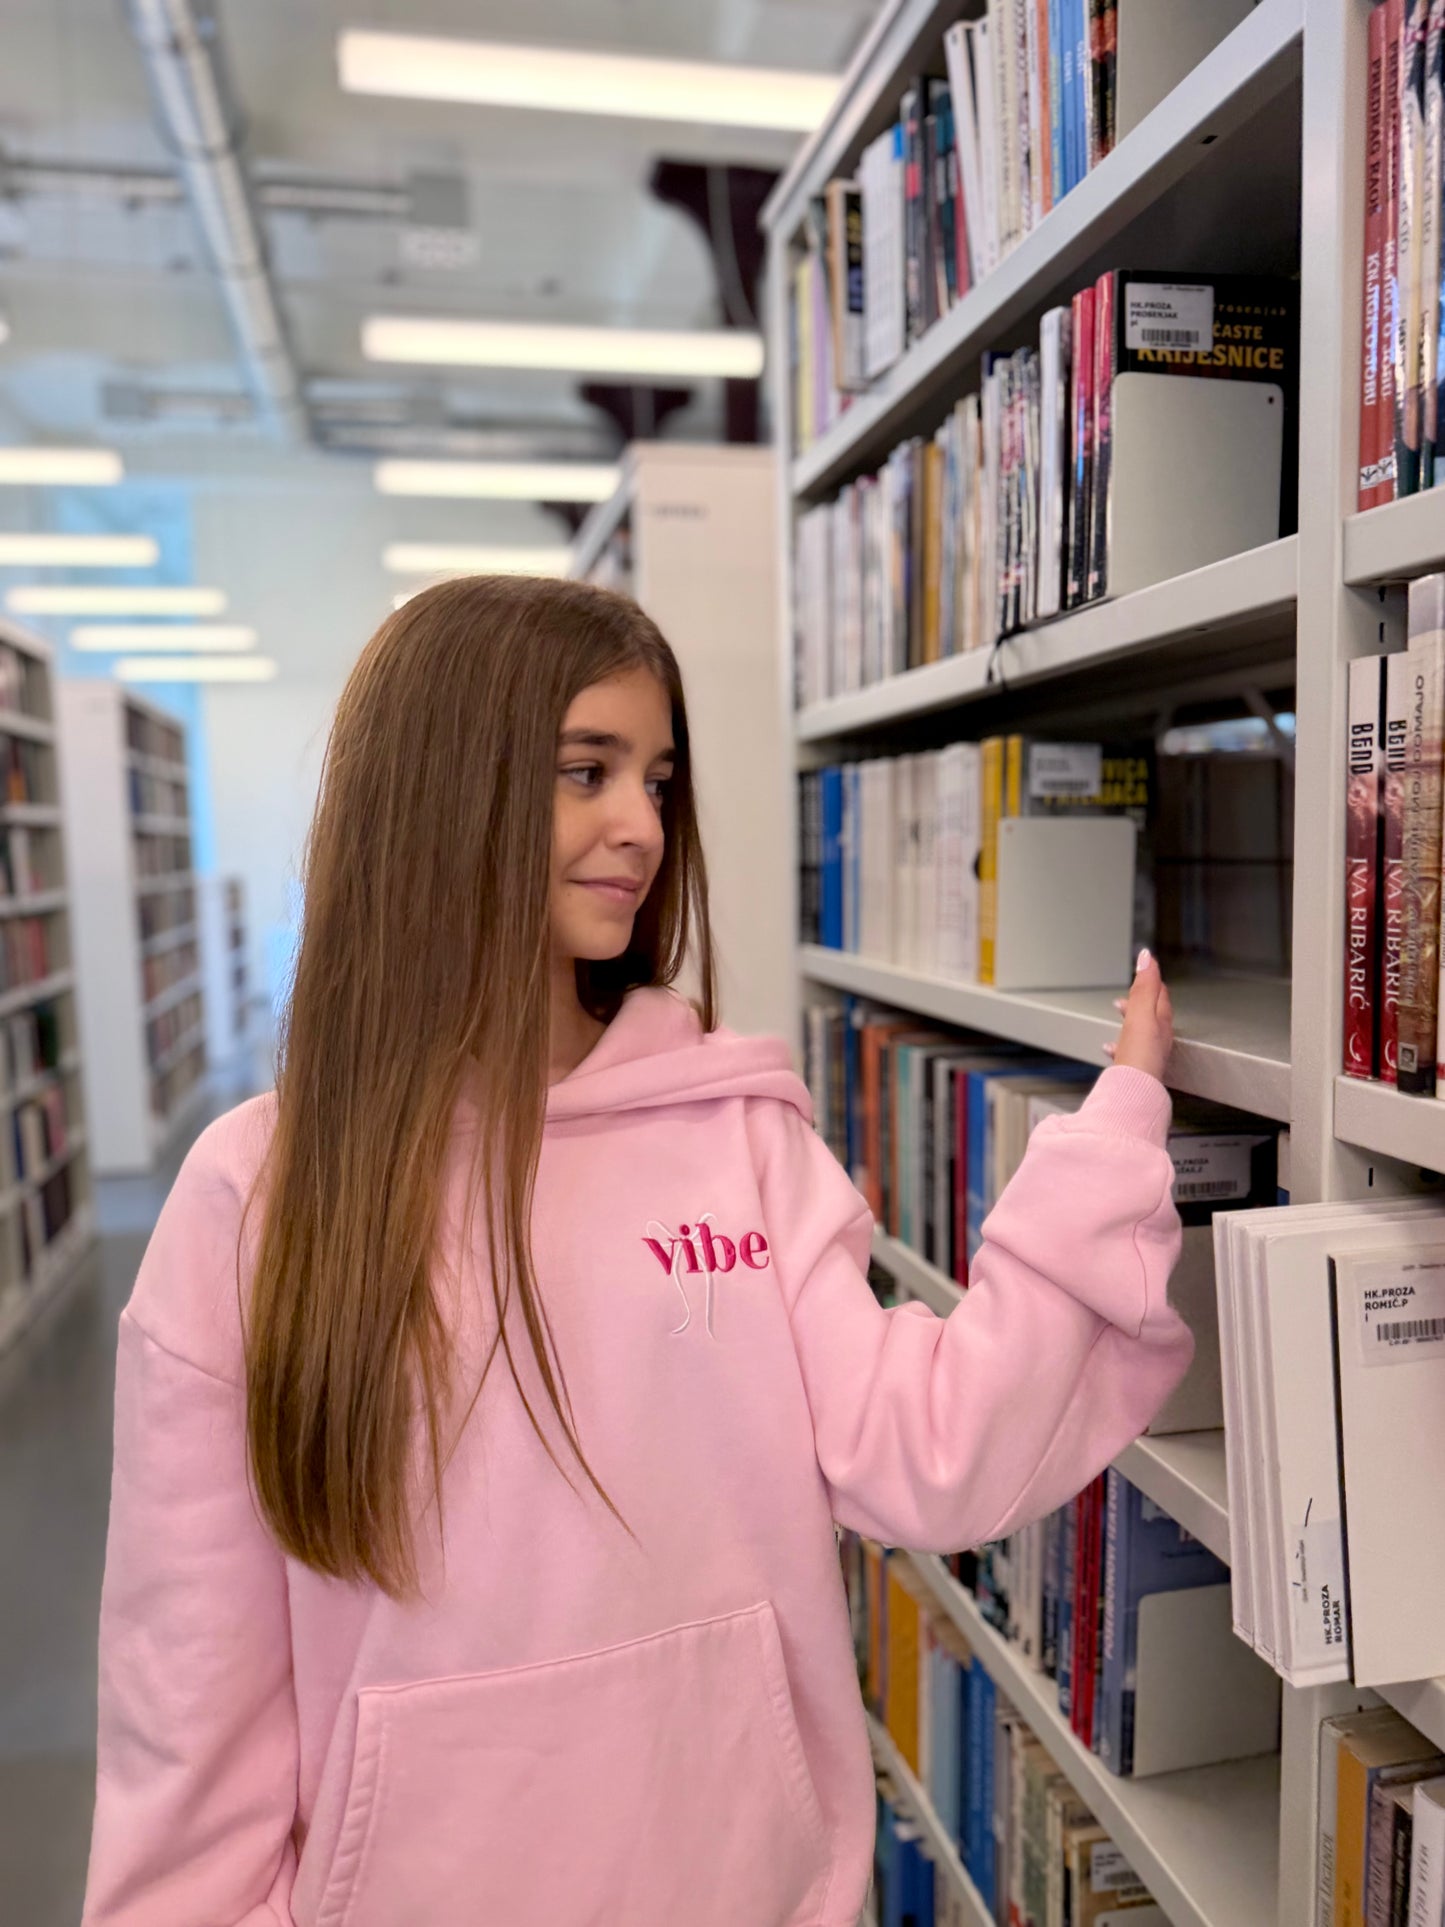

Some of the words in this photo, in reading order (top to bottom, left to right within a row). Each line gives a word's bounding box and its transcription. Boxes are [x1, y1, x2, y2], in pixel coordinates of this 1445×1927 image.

[1369, 58, 1382, 155] PREDRAG
[1130, 302, 1172, 310] HK.PROZA
[1366, 252, 1381, 329] KNJIGA
[1130, 311, 1179, 319] PROSENJAK
[1351, 857, 1369, 898] IVA
[1387, 858, 1404, 900] IVA
[1350, 906, 1371, 1010] RIBARIĆ
[641, 1222, 769, 1276] vibe
[1364, 1286, 1416, 1299] HK.PROZA
[1365, 1298, 1409, 1311] ROMIĆ.P
[1322, 1584, 1332, 1645] HK.PROZA
[1333, 1600, 1343, 1643] ROMAR
